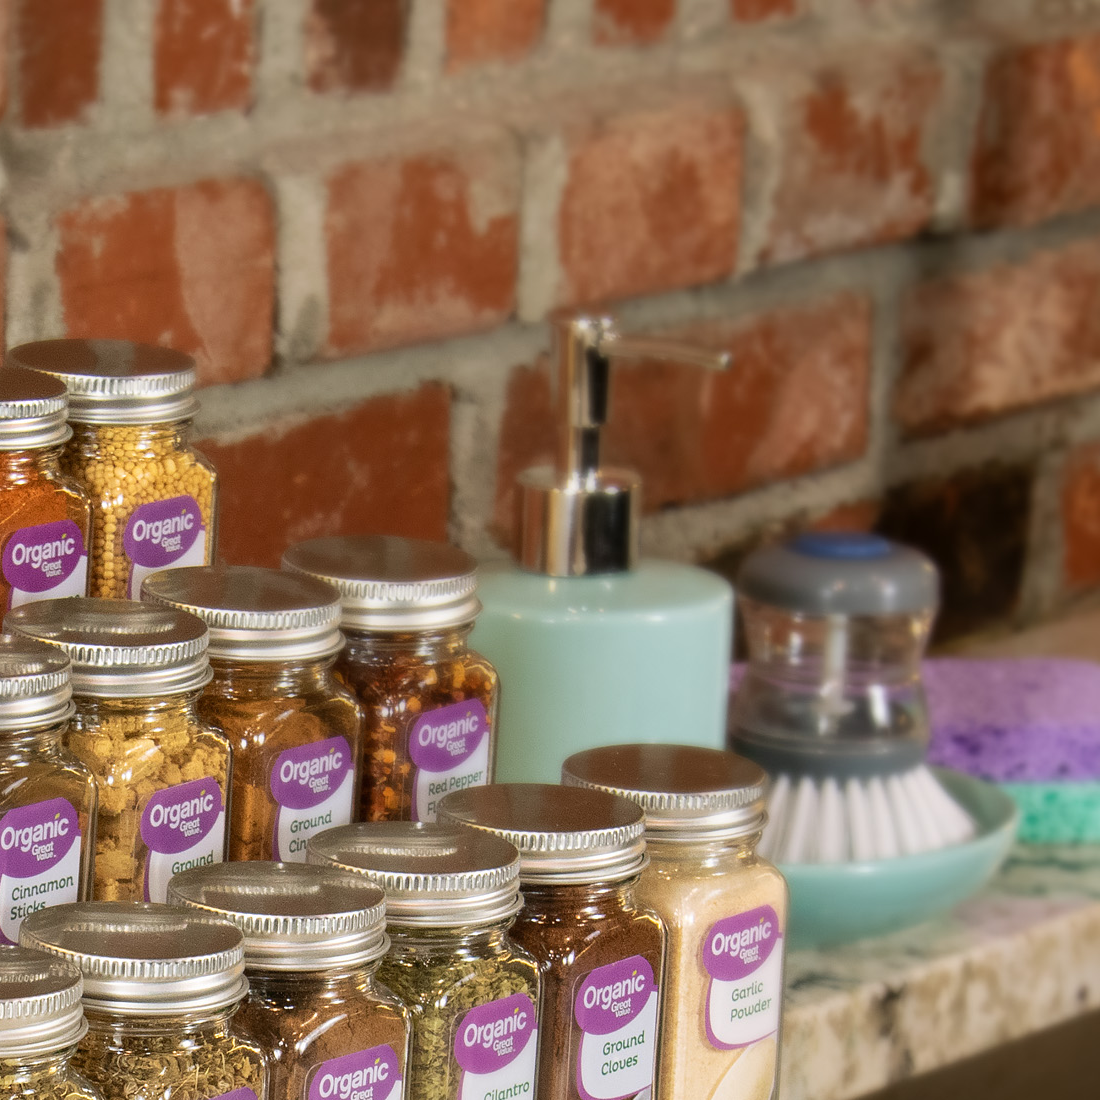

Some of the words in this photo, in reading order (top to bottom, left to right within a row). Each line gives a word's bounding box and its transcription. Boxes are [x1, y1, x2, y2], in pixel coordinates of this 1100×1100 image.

[133, 509, 194, 543] Organic
[12, 534, 75, 568] Organic
[161, 535, 181, 548] Great
[42, 560, 62, 572] Great
[419, 711, 478, 748] Organic
[446, 737, 466, 751] Great
[280, 748, 342, 785] Organic
[309, 774, 329, 788] Great
[428, 779, 447, 796] Red
[449, 771, 483, 792] Pepper
[150, 790, 213, 829] Organic
[1, 813, 69, 852] Organic
[180, 817, 200, 831] Great
[184, 827, 200, 837] Value
[290, 810, 332, 833] Ground
[32, 841, 54, 855] Great
[37, 851, 53, 861] Value
[172, 850, 213, 875] Ground
[12, 876, 74, 901] Cinnamon
[11, 901, 46, 920] Sticks
[712, 917, 772, 957] Organic
[740, 945, 758, 959] Great
[584, 970, 645, 1010] Organic
[732, 981, 763, 1002] Garlic
[611, 998, 631, 1013] Great
[615, 1008, 630, 1018] Value
[731, 998, 772, 1022] Powder
[464, 1007, 527, 1048] Organic
[493, 1036, 513, 1051] Great
[603, 1030, 645, 1055] Ground
[601, 1054, 638, 1075] Cloves
[319, 1057, 388, 1099] Organic
